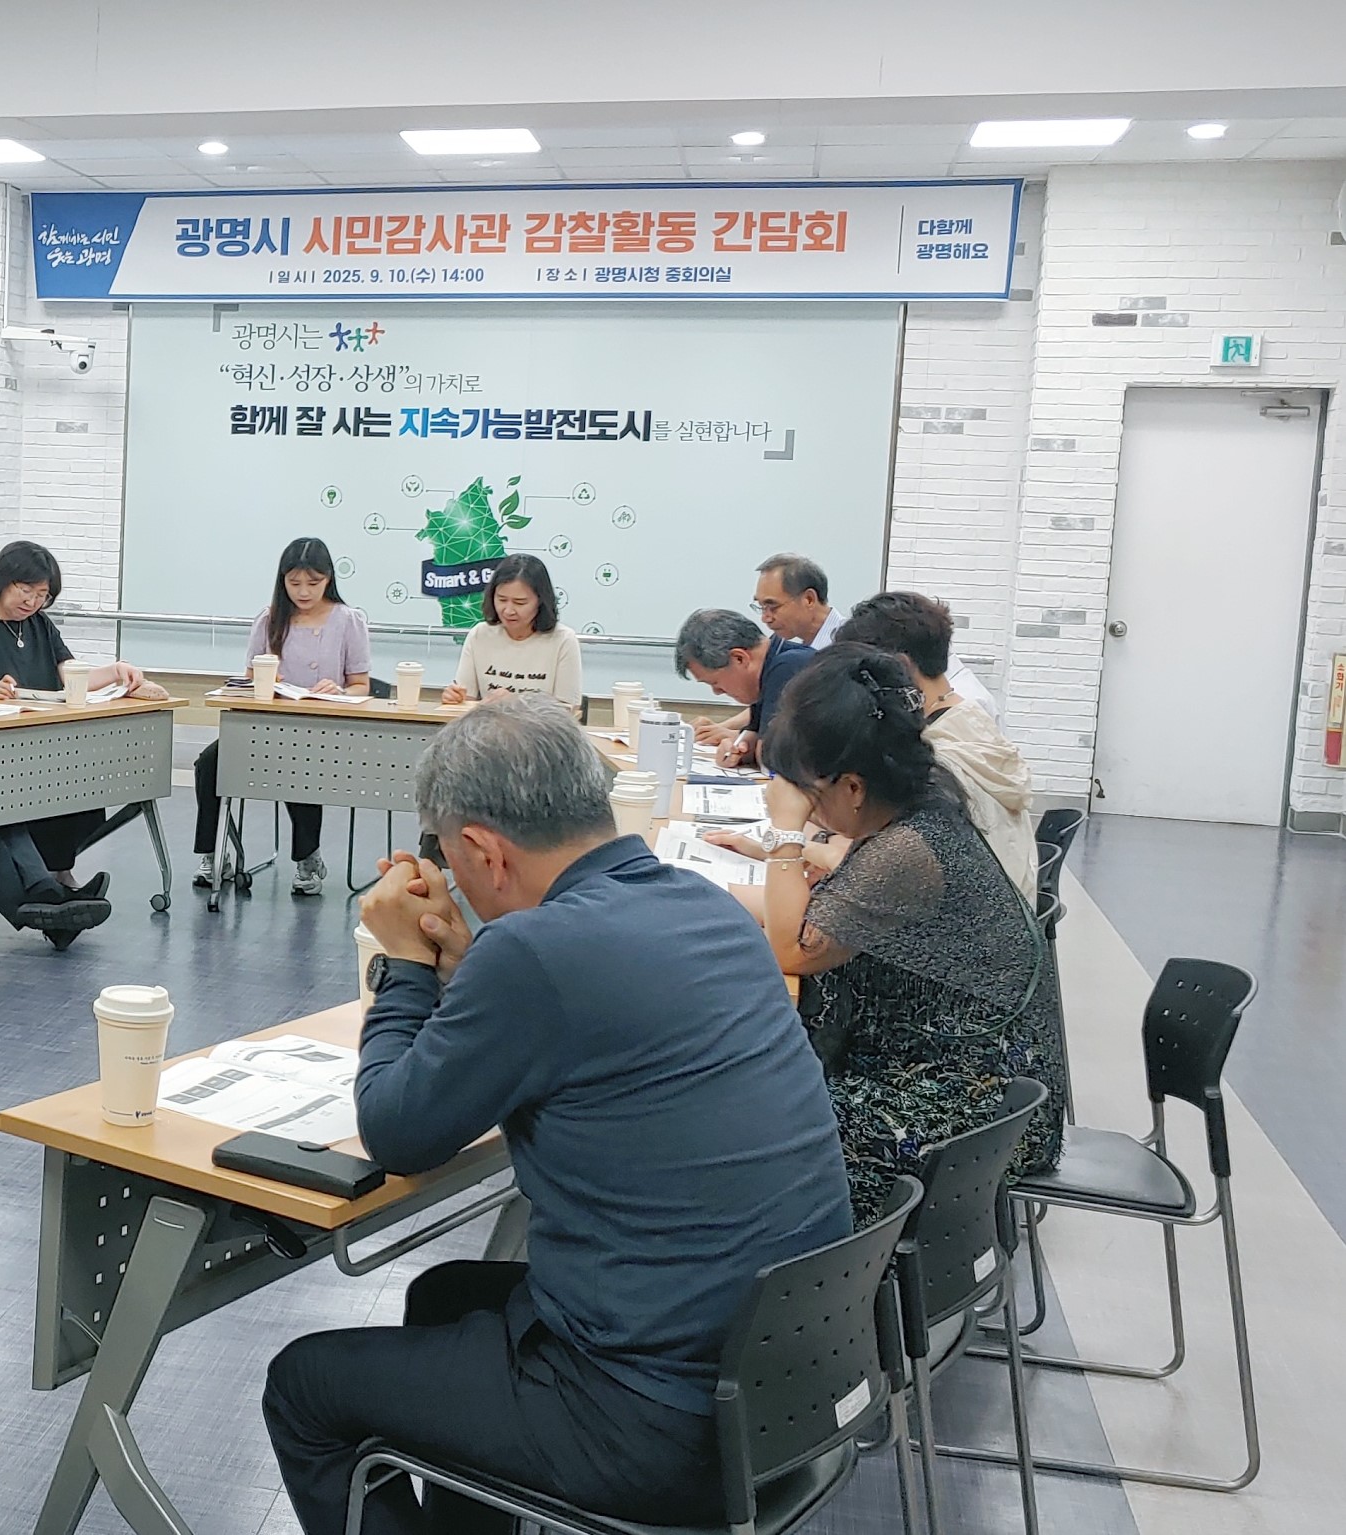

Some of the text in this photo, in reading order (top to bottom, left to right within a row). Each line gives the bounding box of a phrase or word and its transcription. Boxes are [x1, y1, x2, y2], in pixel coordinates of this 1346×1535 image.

[91, 226, 121, 245] 시민
[175, 210, 848, 257] 광명시 시민감사관 감찰활동 간담회
[917, 218, 973, 236] 다함께
[75, 246, 113, 267] 광명
[915, 242, 989, 260] 광명해요
[322, 269, 365, 284] 2025.
[441, 268, 484, 283] 14:00
[594, 266, 660, 283] 광명시청
[665, 266, 732, 283] 중회의실
[231, 322, 324, 350] 광명시는
[426, 373, 483, 395] 가치로
[230, 404, 288, 436] 함께
[295, 406, 327, 437] 잘
[332, 406, 392, 438] 사는
[674, 420, 773, 443] 실현합니다
[424, 570, 468, 588] Smart
[468, 569, 481, 586] &
[1335, 663, 1345, 691] 소화기
